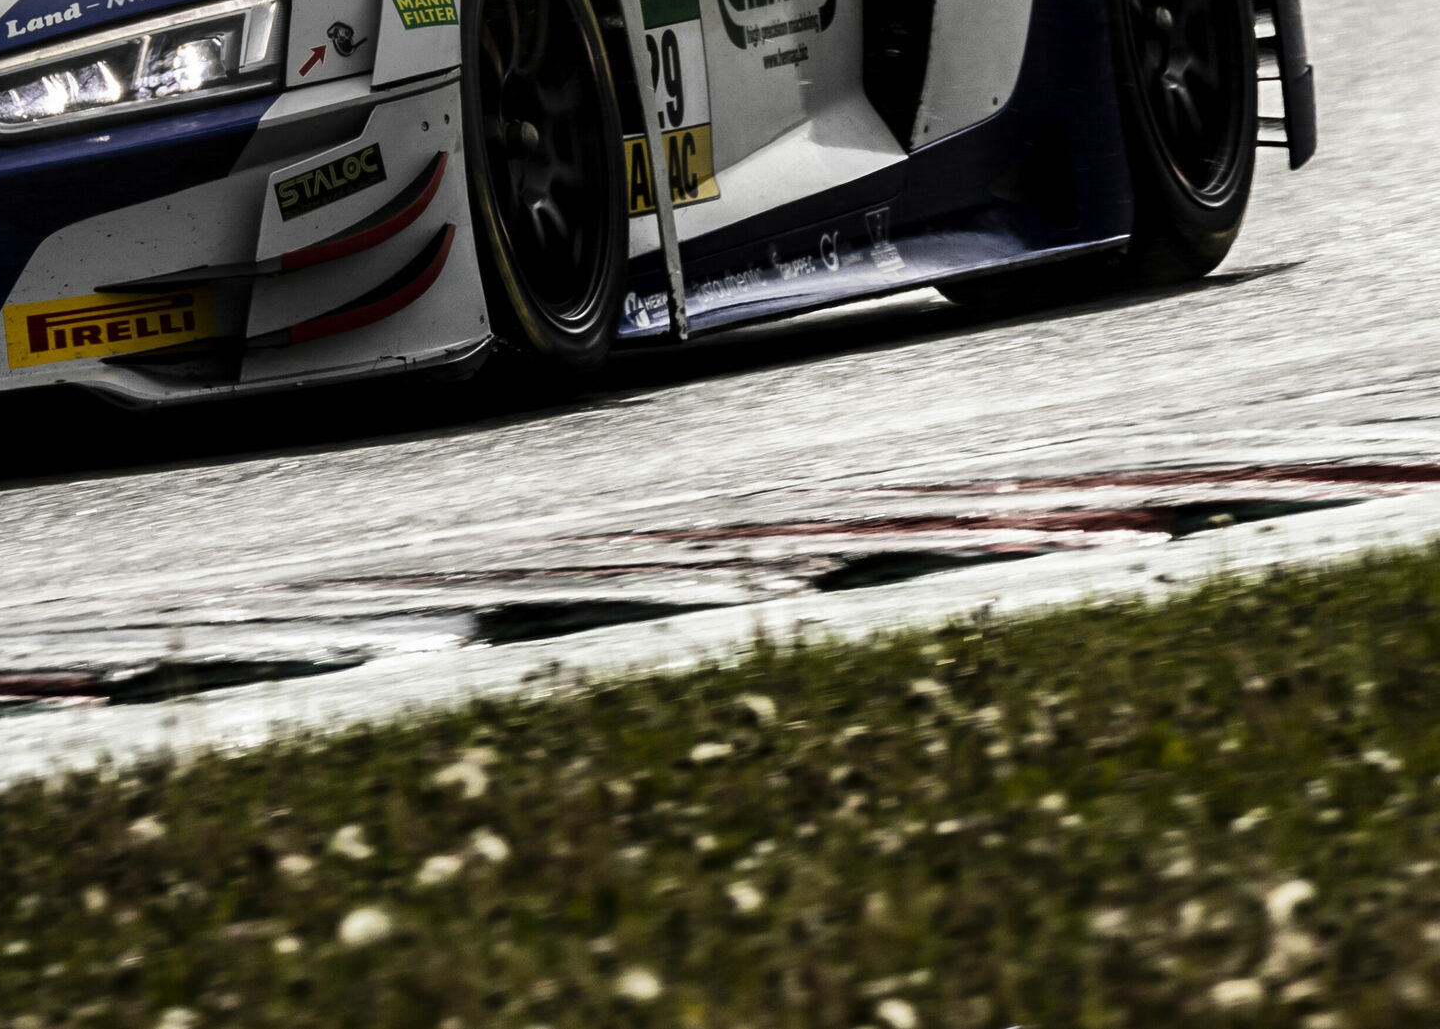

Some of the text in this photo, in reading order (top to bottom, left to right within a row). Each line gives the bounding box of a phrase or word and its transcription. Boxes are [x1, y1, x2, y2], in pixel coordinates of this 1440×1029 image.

[403, 6, 456, 26] FILTER
[278, 147, 378, 208] STALOC
[630, 132, 699, 211] AAC
[27, 292, 197, 353] PIRELLI
